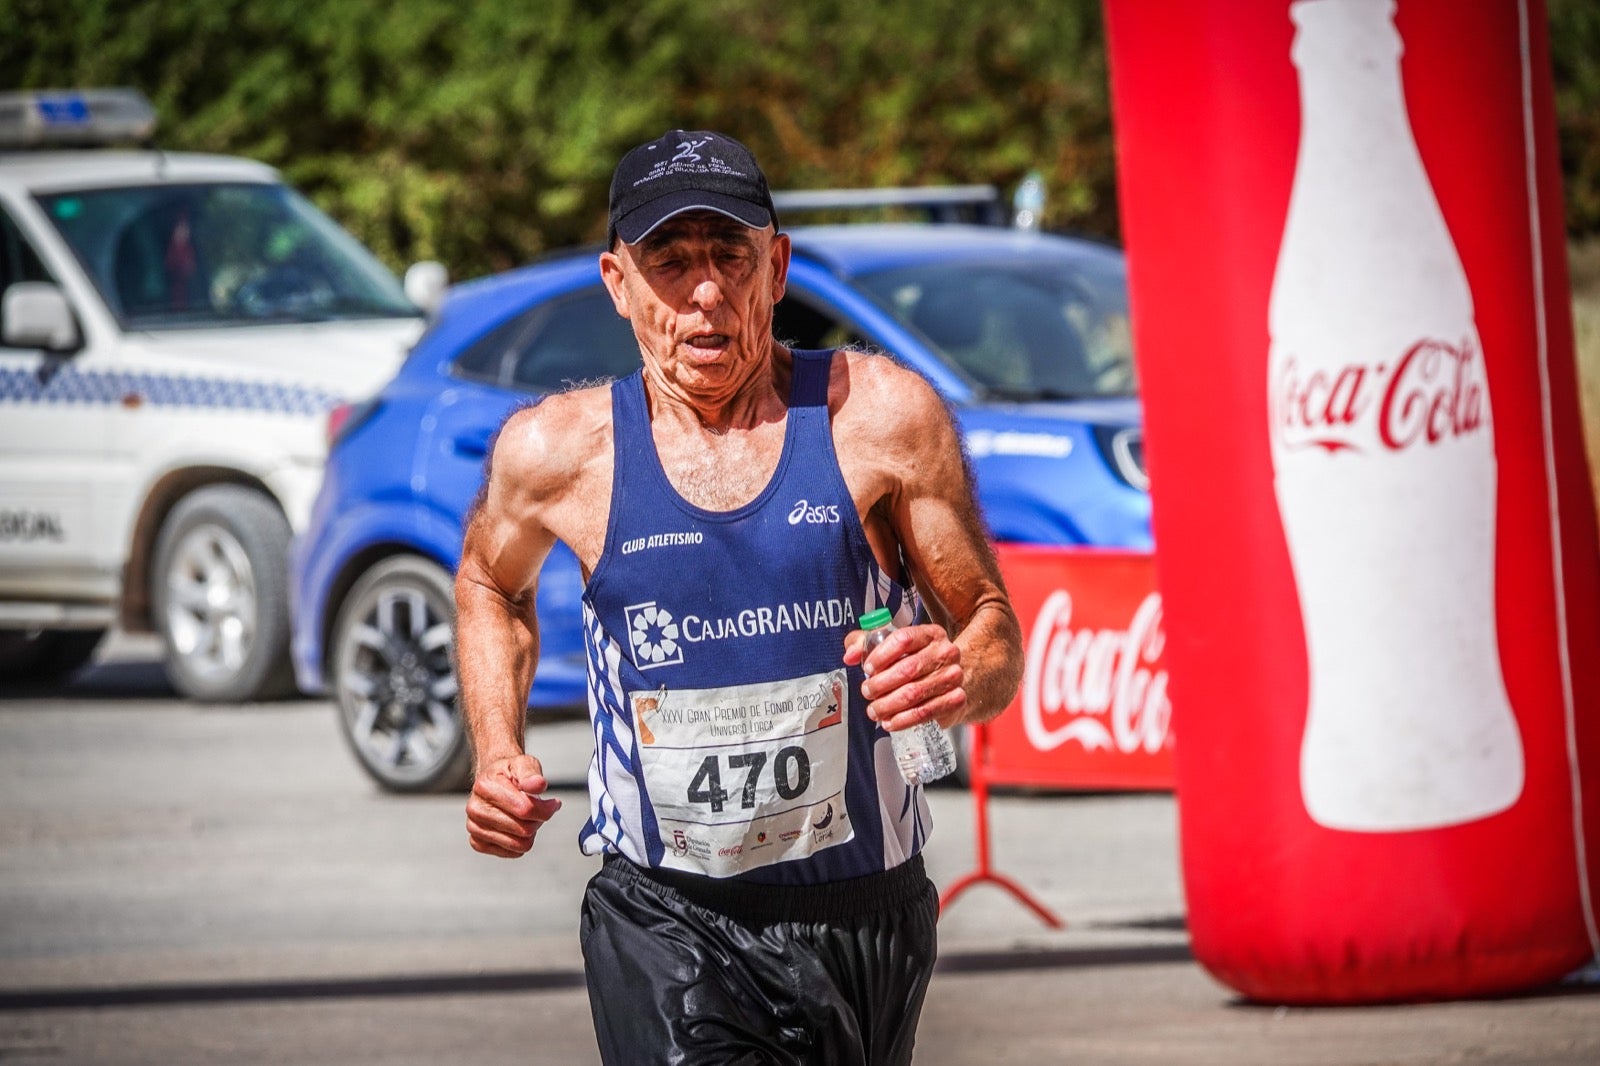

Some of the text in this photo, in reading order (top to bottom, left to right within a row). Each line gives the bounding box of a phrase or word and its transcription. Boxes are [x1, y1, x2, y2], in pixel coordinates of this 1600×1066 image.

[1277, 337, 1486, 455] Coca-Cola
[804, 504, 840, 524] asics
[622, 532, 703, 555] CLUB ATLETISMO
[661, 693, 821, 724] XXXV GRAN PREMIO DE FONDO 2022
[710, 719, 774, 737] UNIVERSO LORCA
[686, 746, 811, 813] 470
